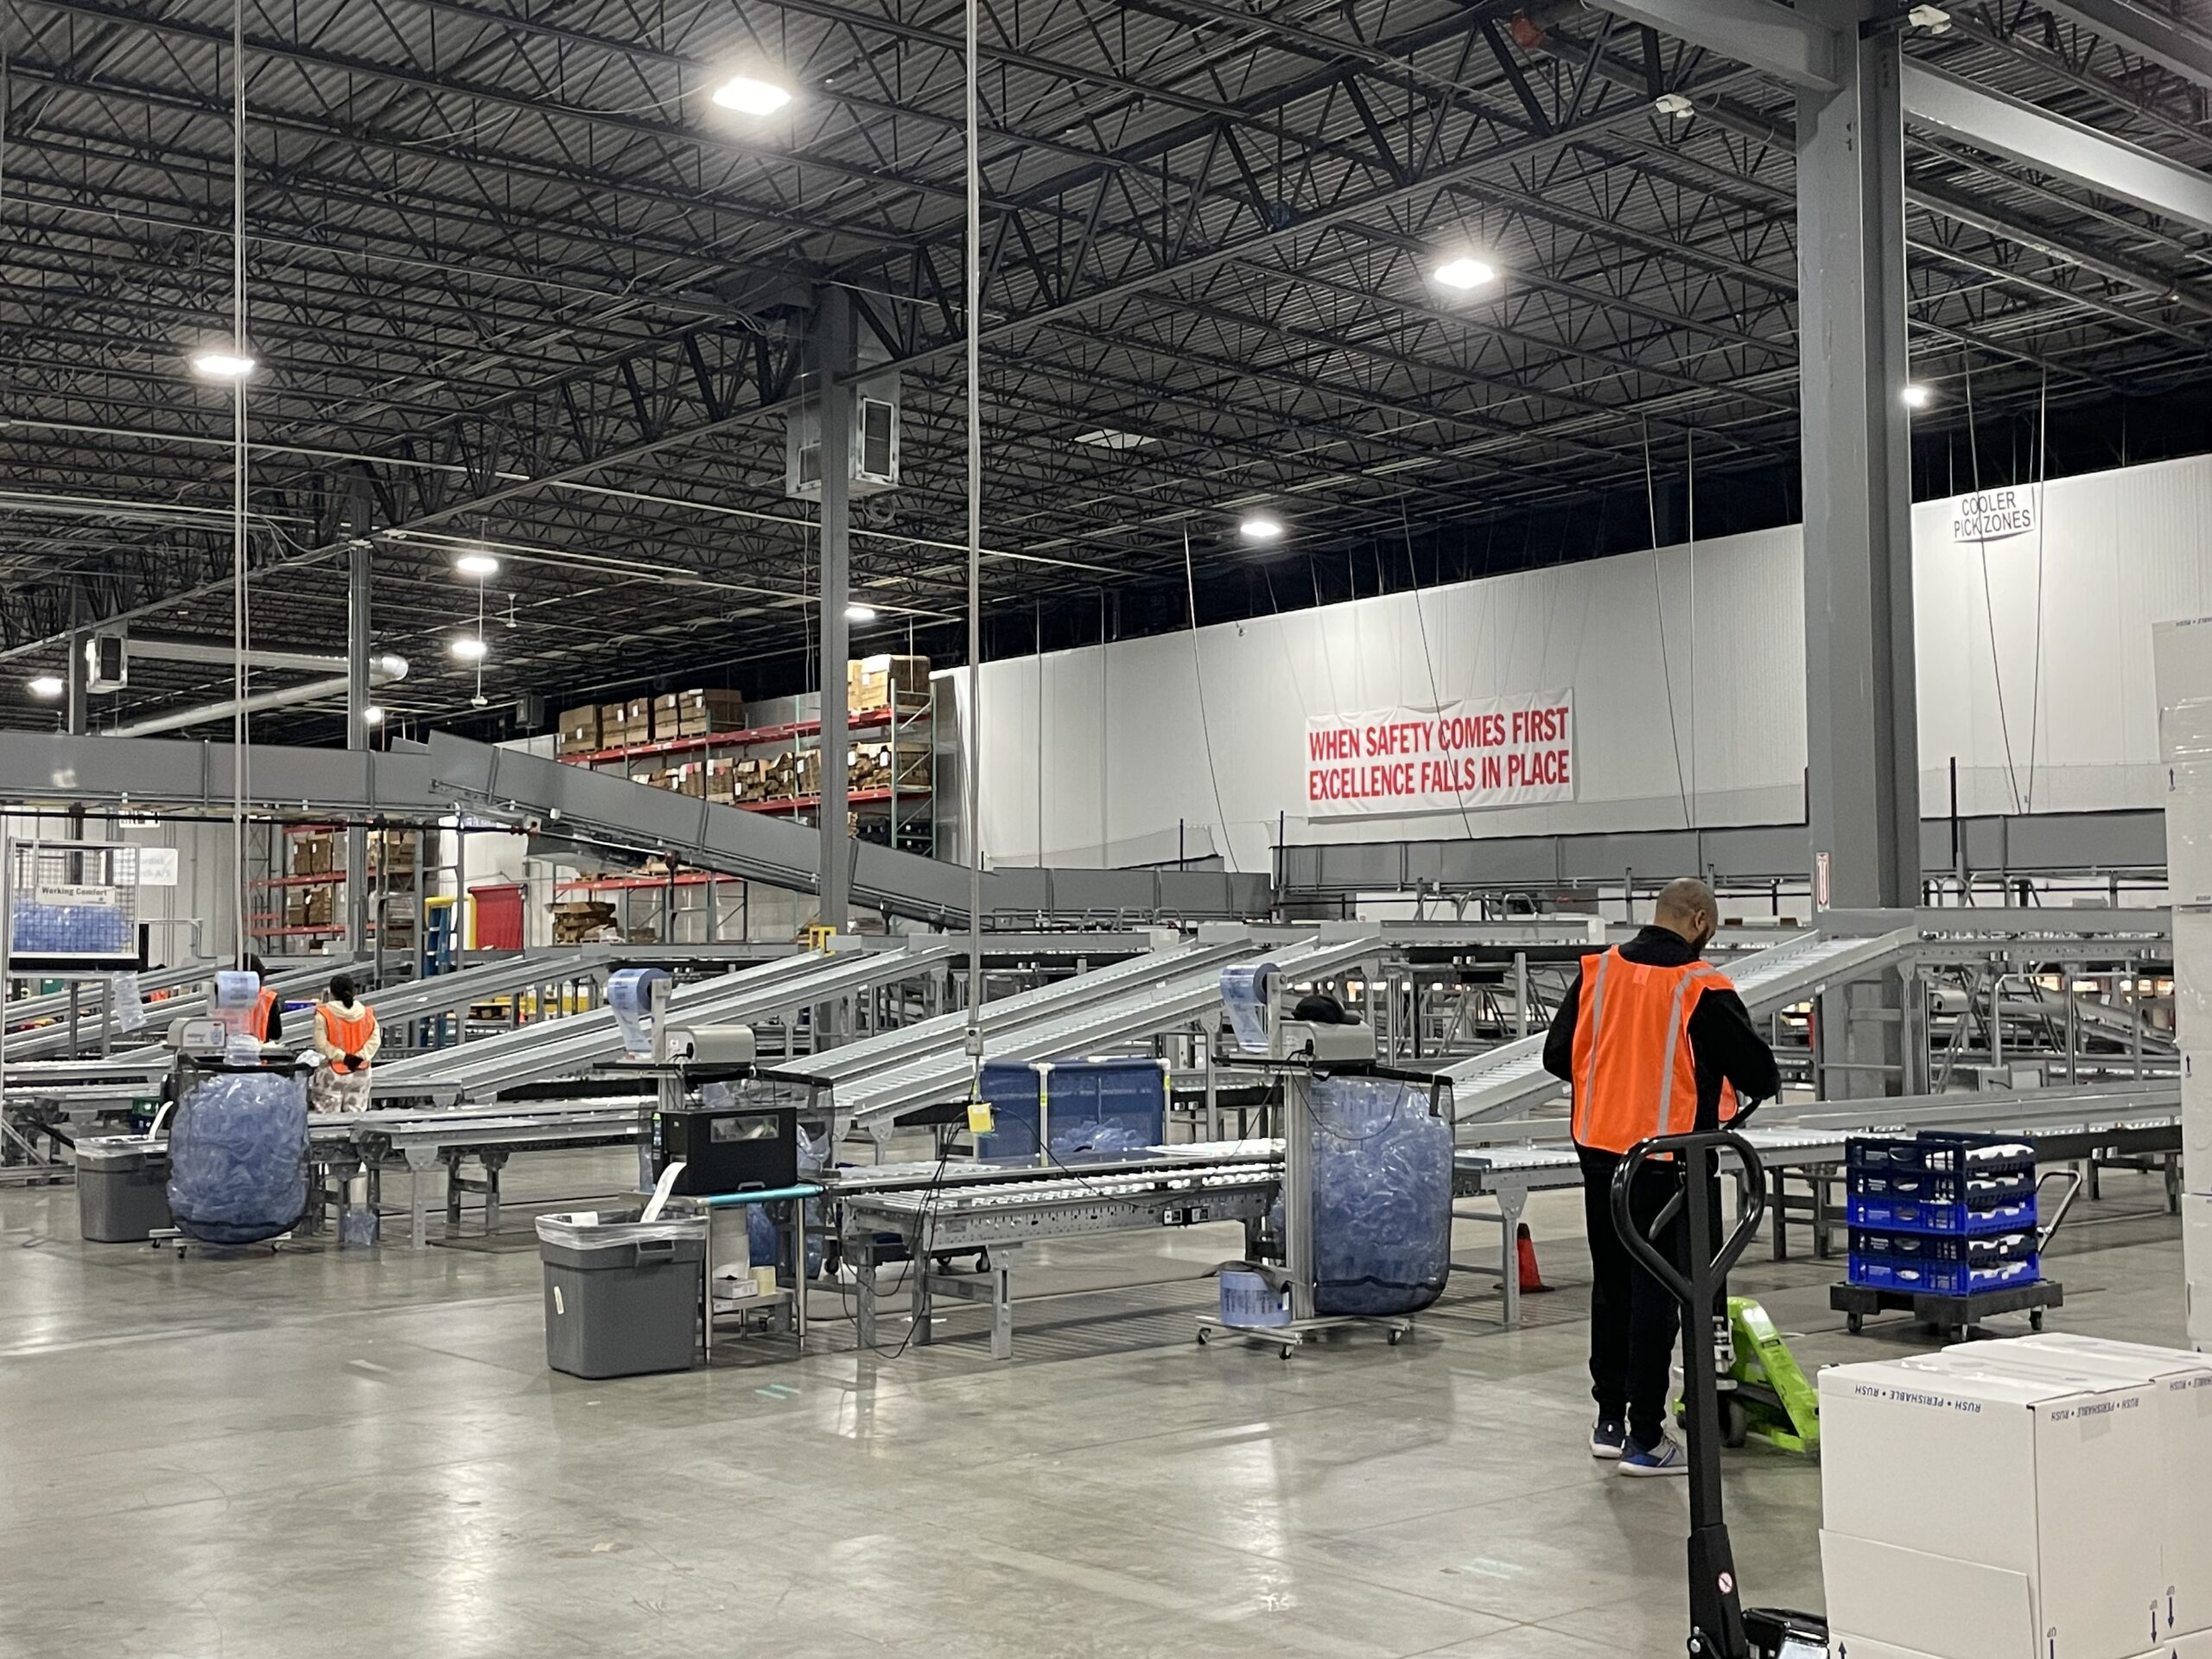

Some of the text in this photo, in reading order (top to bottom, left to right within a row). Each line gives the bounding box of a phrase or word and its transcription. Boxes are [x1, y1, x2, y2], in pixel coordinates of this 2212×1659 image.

[1962, 491, 2016, 516] COOLER
[1954, 509, 2031, 538] PICK ZONES
[1310, 708, 1569, 760] WHEN SAFETY COMES FIRST
[1310, 750, 1570, 800] EXCELLENCE FALLS IN PLACE
[41, 887, 108, 897] Working Comfort
[1854, 1384, 1981, 1413] RUSH PERISHABLE RUSH
[2050, 1398, 2139, 1422] RUSH PERISHABLE RUSH
